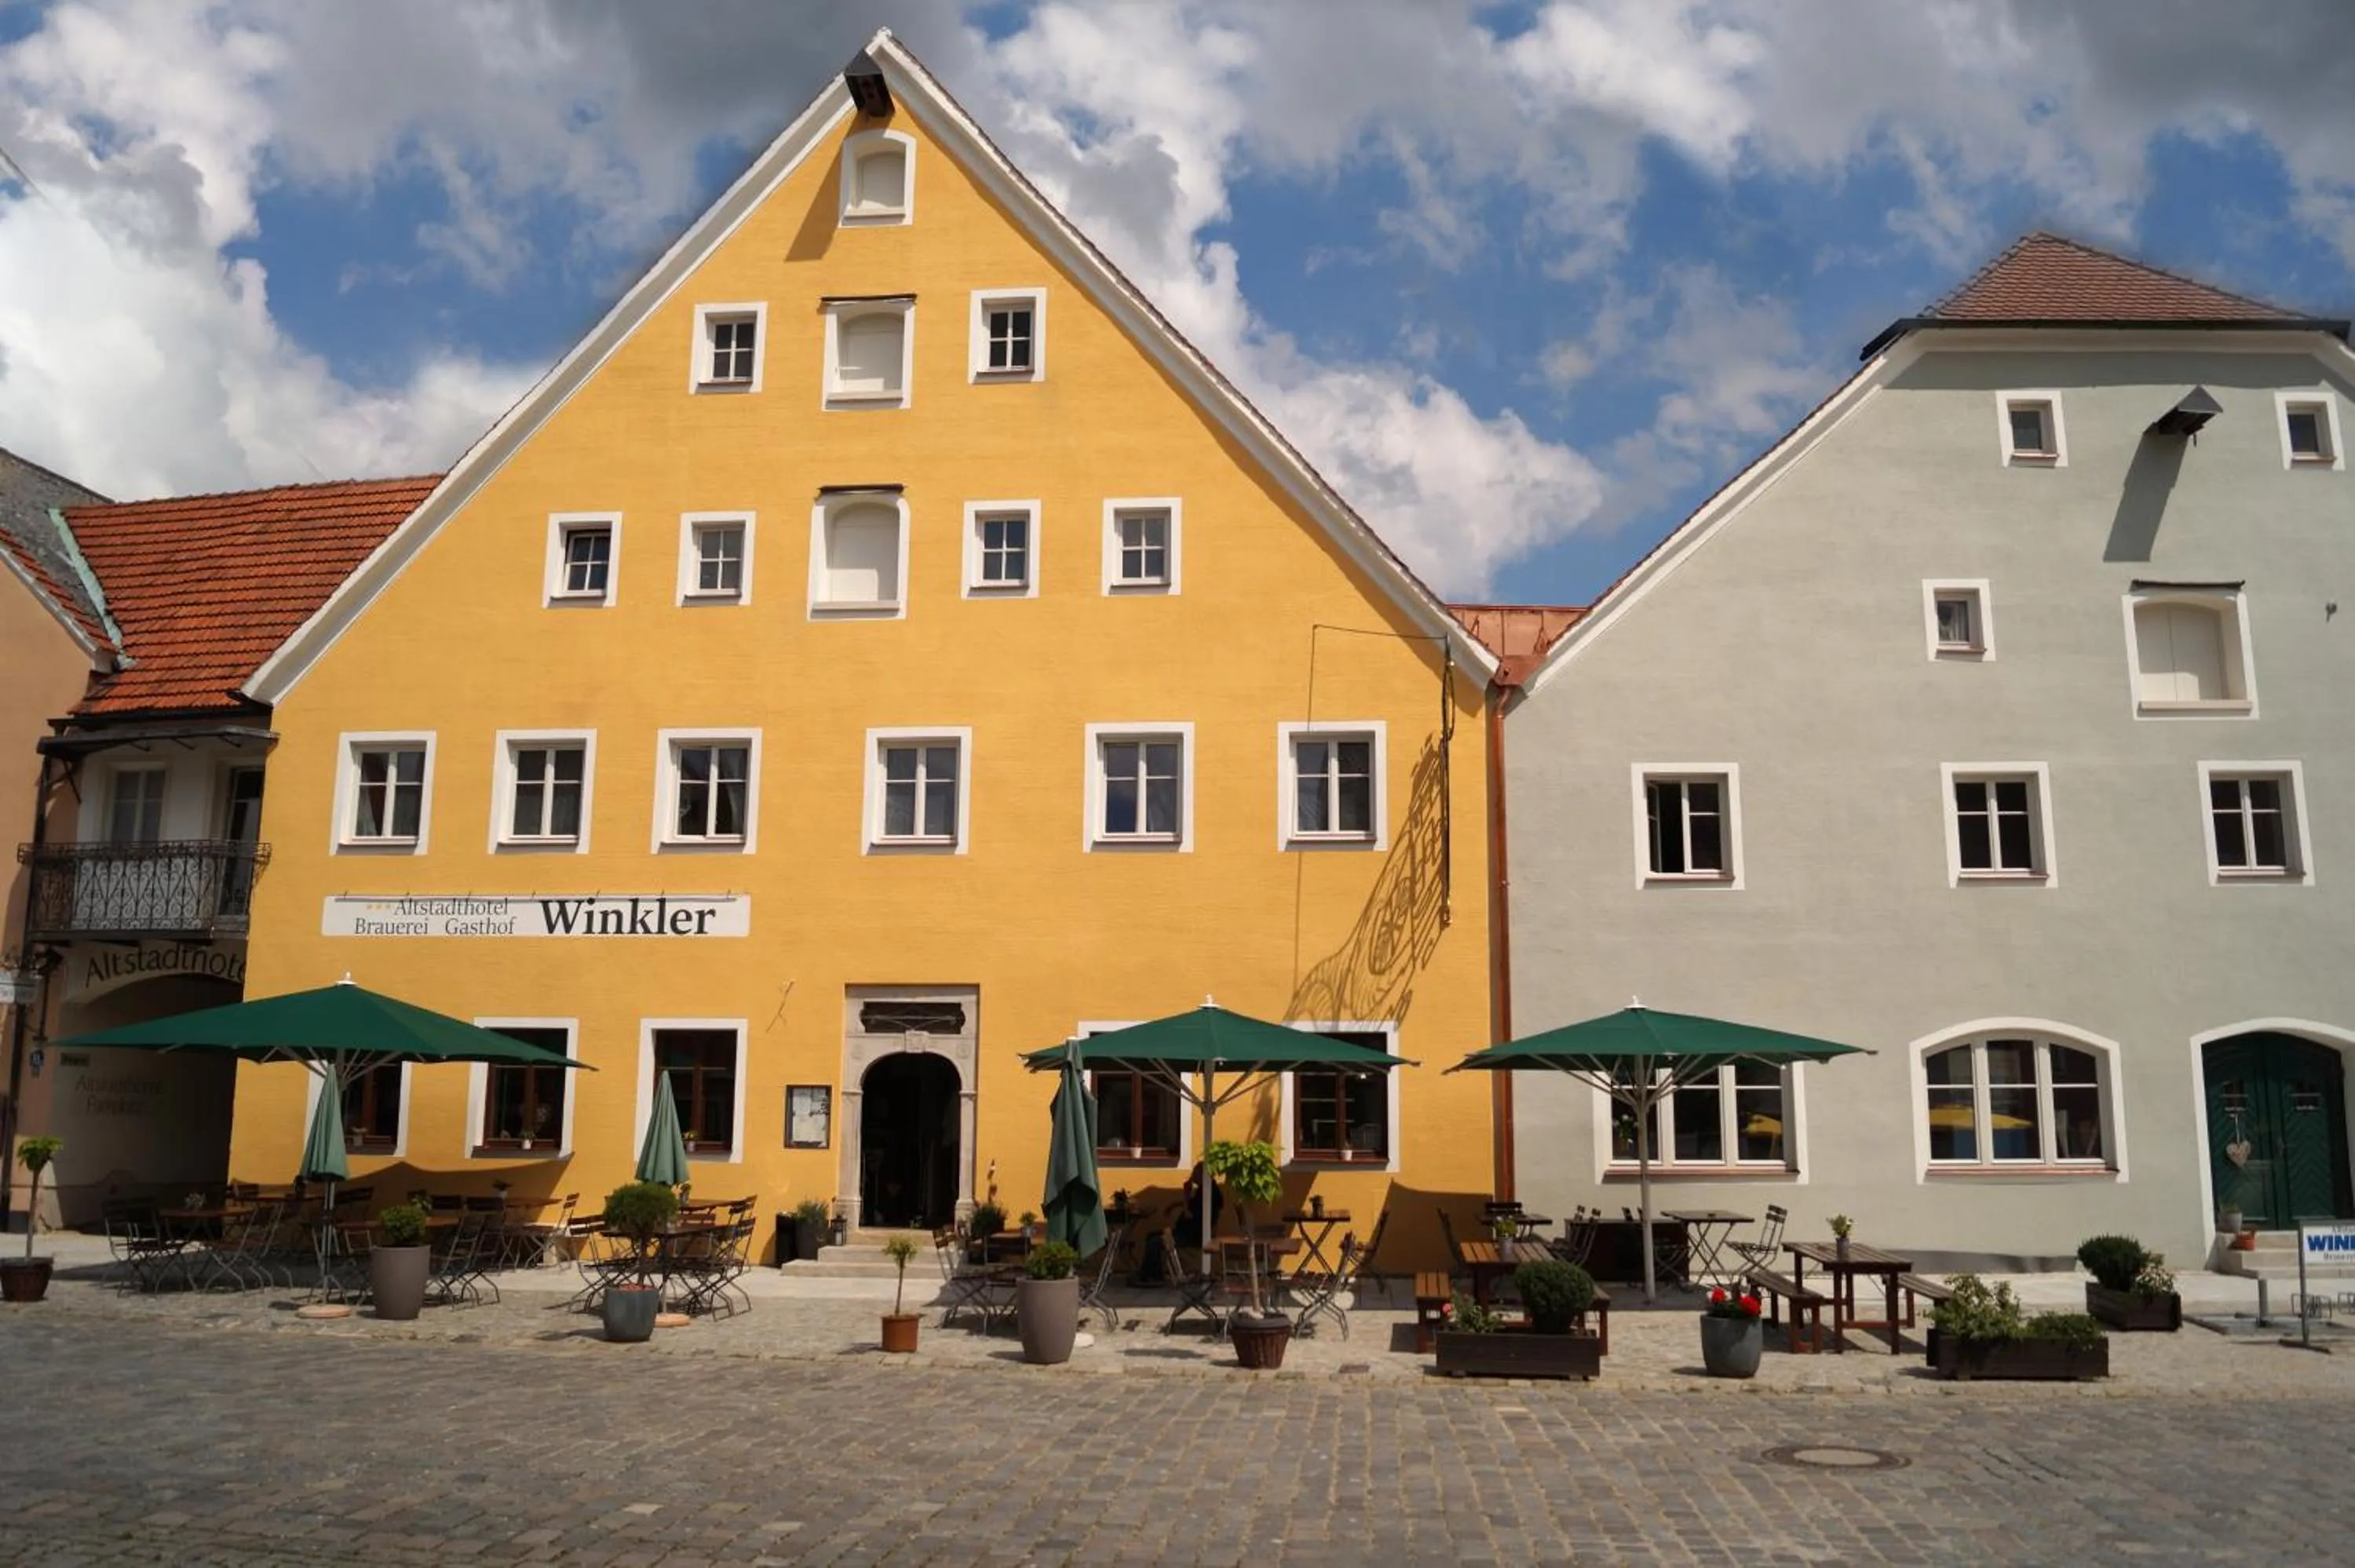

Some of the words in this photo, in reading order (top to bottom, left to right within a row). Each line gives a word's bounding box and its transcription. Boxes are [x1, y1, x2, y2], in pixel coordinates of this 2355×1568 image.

[394, 898, 509, 916] Altstadthotel
[539, 897, 717, 935] Winkler
[355, 917, 429, 935] Brauerei
[444, 916, 517, 935] Gasthof
